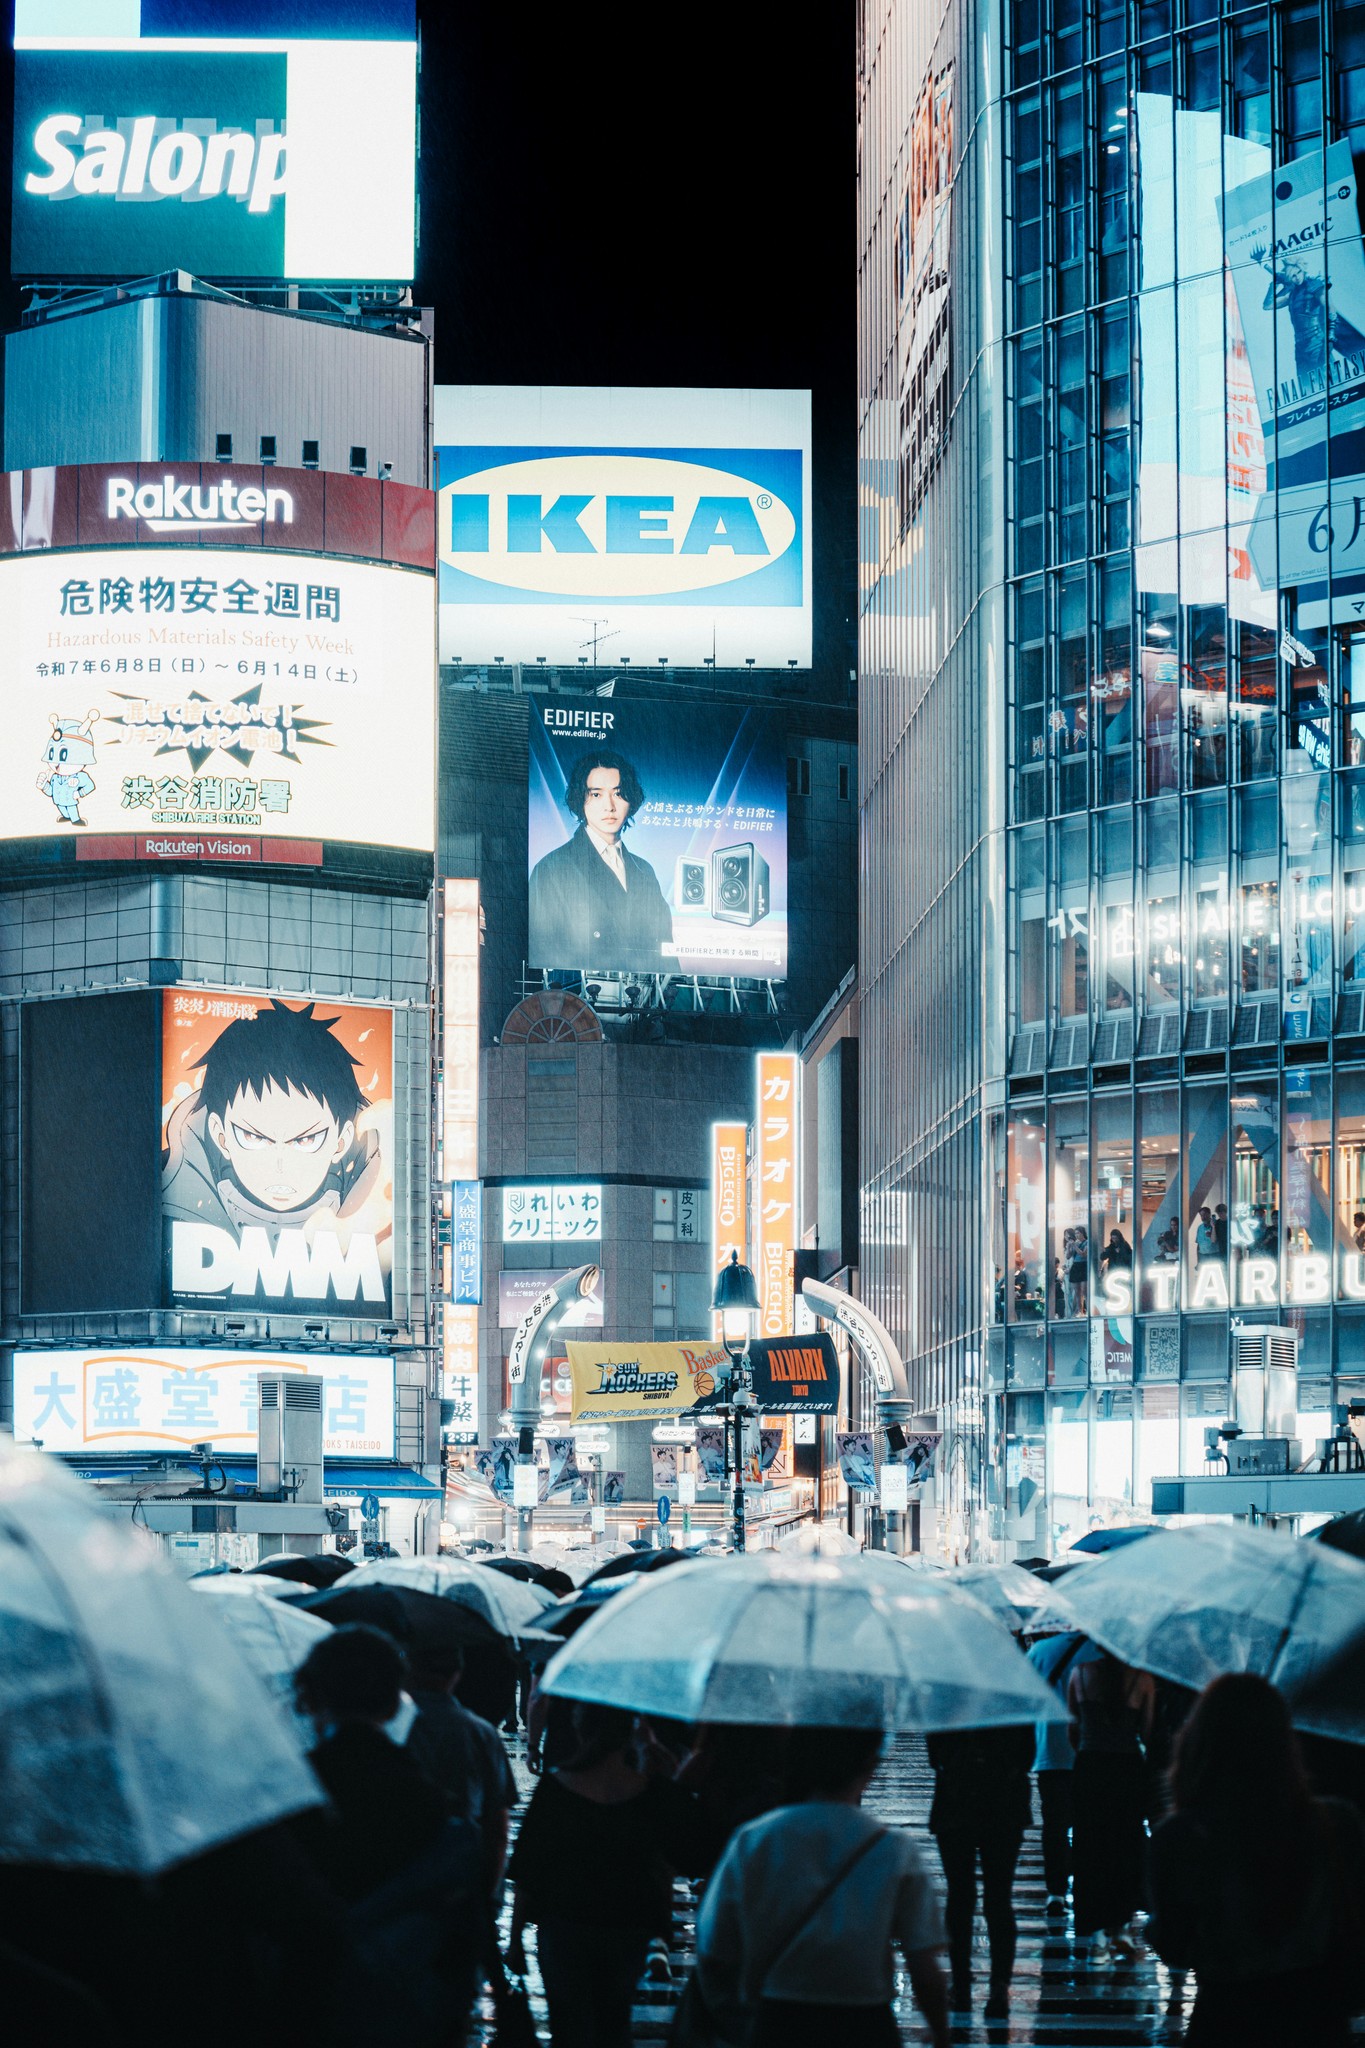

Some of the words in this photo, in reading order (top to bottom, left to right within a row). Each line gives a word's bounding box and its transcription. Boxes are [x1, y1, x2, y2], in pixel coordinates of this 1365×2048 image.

[25, 115, 288, 212] Salonp
[1269, 217, 1334, 257] MAGIC
[107, 475, 294, 525] Rakuten
[451, 494, 771, 555] IKEA
[59, 576, 341, 623] 危険物安全週間
[47, 628, 142, 649] Hazardous
[147, 627, 237, 646] Materials
[241, 630, 299, 655] Safety
[304, 634, 355, 656] Week
[543, 708, 615, 729] EDIFIER
[551, 729, 607, 739] www.edifier.jp
[120, 775, 292, 813] 渋谷消防署
[151, 811, 194, 824] SHIBUYA
[194, 812, 218, 824] FIRE
[218, 812, 262, 826] STATION
[146, 839, 204, 857] Rakuten
[207, 840, 252, 855] Vision
[173, 996, 258, 1020] 炎炎ノ消防隊
[719, 1146, 736, 1178] BIG
[763, 1076, 792, 1223] カラオケ
[530, 1192, 599, 1213] れいわ
[681, 1191, 694, 1237] 皮フ科
[720, 1181, 736, 1227] ECHO
[458, 1187, 477, 1298] 大盛堂商事ビル
[508, 1217, 599, 1238] クリニック
[171, 1220, 386, 1301] DMM
[764, 1243, 784, 1278] BIG
[1103, 1253, 1365, 1312] STARBU
[765, 1282, 783, 1334] ECHO
[511, 1293, 552, 1380] 渋谷センター街
[590, 1362, 679, 1394] ROCKERS
[617, 1363, 639, 1373] SUN
[768, 1348, 828, 1381] ALVARK
[32, 1369, 368, 1434] 大盛堂店
[642, 1392, 670, 1401] SHIBUYA
[345, 1440, 381, 1450] TAISEIDO
